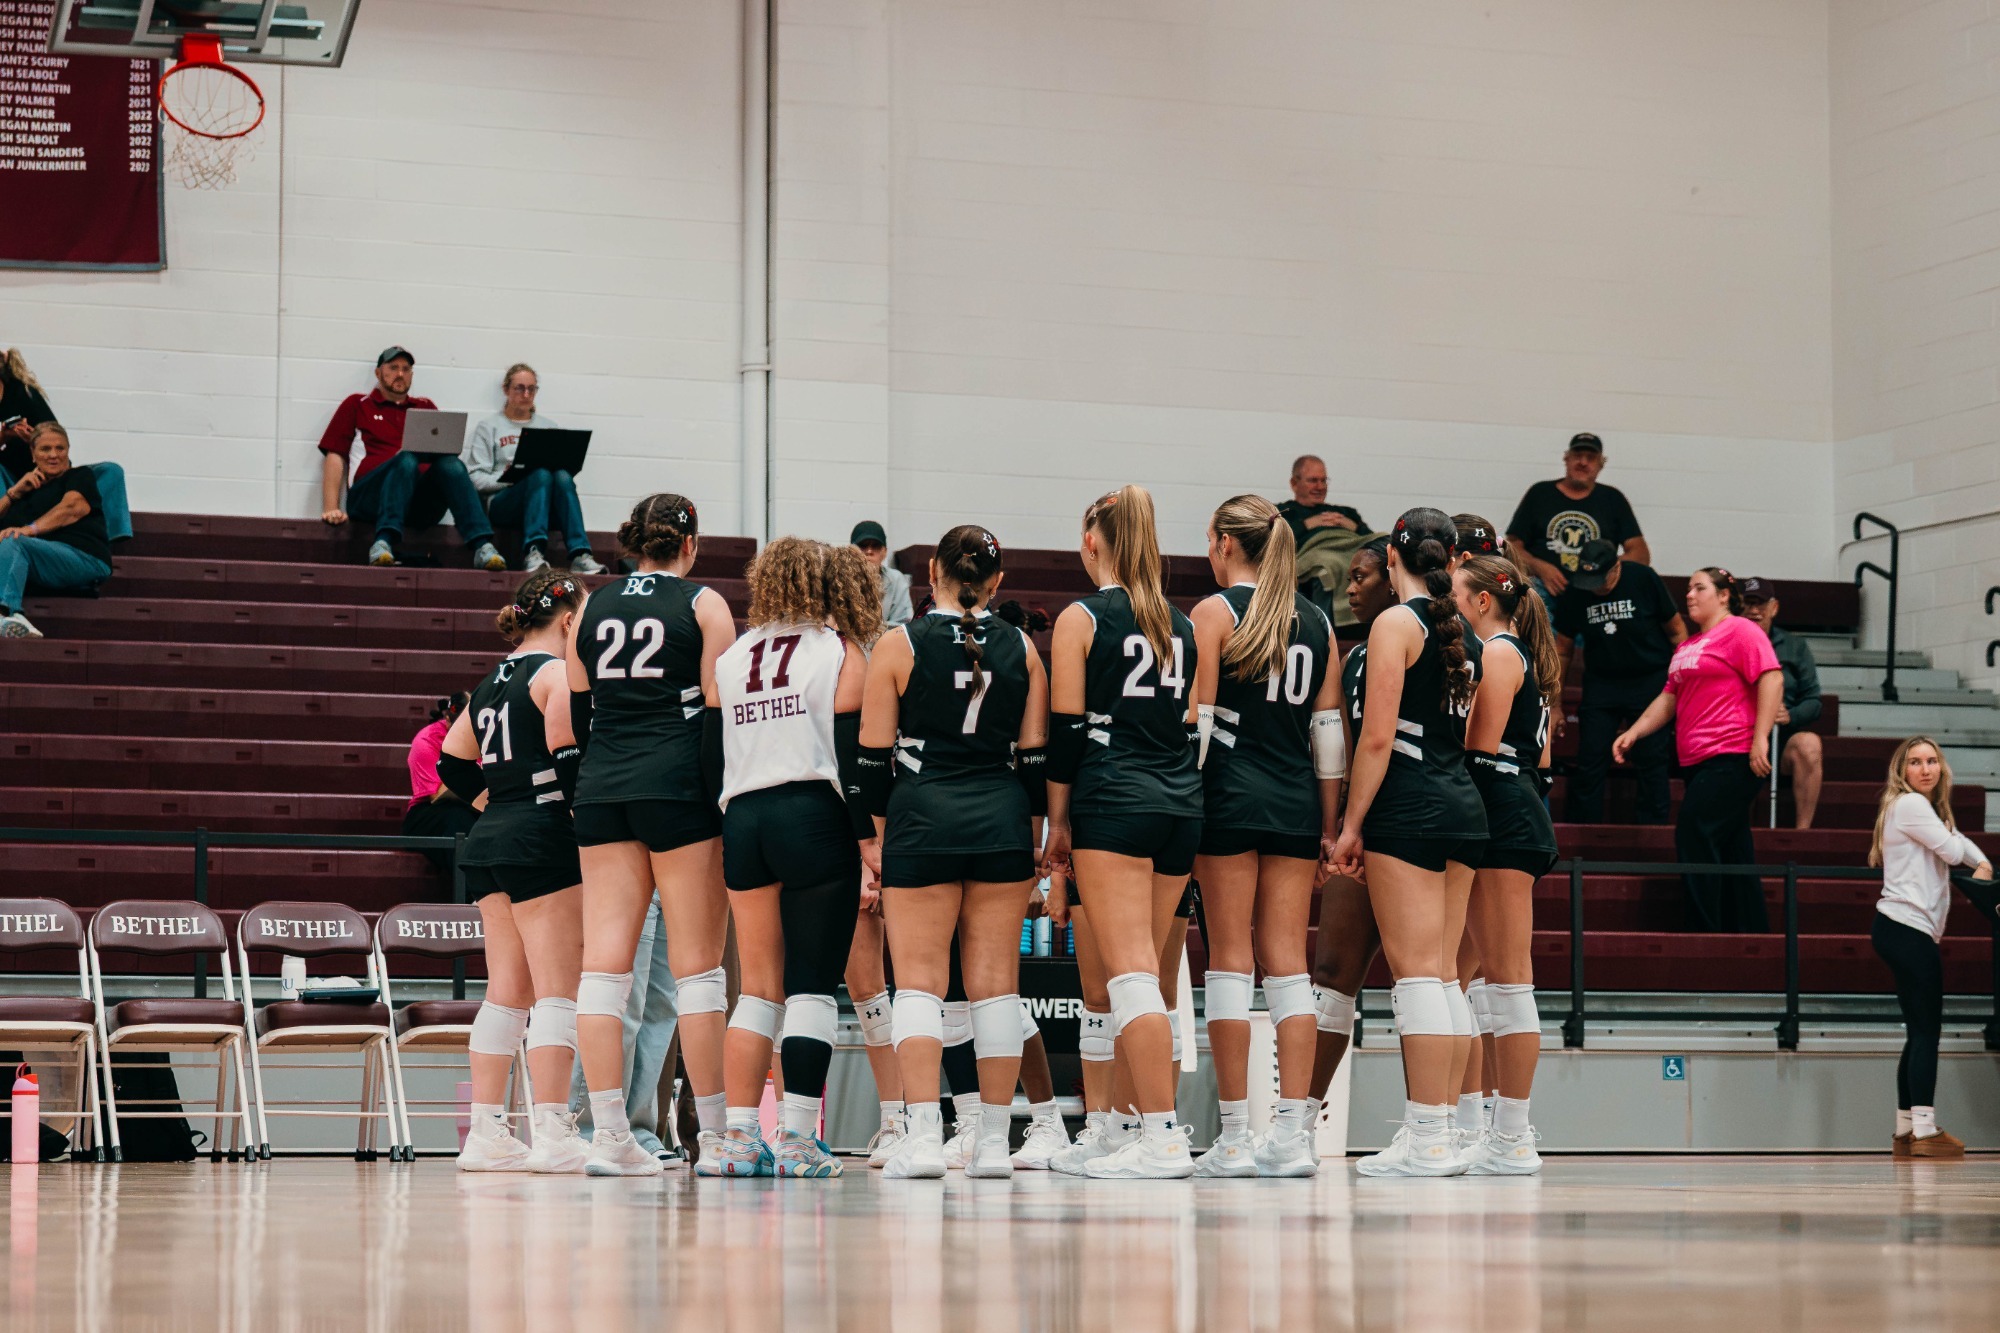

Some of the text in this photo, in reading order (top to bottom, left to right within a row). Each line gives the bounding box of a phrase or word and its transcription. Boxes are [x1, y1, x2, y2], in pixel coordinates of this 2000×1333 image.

[0, 2, 15, 12] SH
[0, 15, 49, 27] EGAN MA
[0, 28, 15, 39] SH
[0, 54, 151, 69] ANTZ SCURRY 2021
[16, 69, 59, 80] SEABOLT
[129, 72, 151, 82] 2021
[31, 83, 71, 94] MARTIN
[129, 85, 151, 95] 2021
[15, 95, 55, 106] PALMER
[129, 98, 151, 108] 2021
[15, 108, 55, 119] PALMER
[129, 111, 152, 121] 2022
[31, 122, 71, 132] MARTIN
[129, 123, 152, 134] 2022
[16, 134, 59, 145] SEABOLT
[129, 136, 152, 146] 2022
[0, 146, 151, 159] ENDEN SANDERS 2022
[16, 161, 87, 171] JUNKERMEIER
[499, 434, 520, 447] BE
[622, 577, 656, 596] BC
[597, 618, 665, 679] 22
[745, 634, 802, 694] 17
[1122, 634, 1185, 699] 24
[954, 671, 992, 734] 7
[733, 695, 807, 726] BETHEL
[477, 701, 512, 764] 21
[0, 914, 64, 933] THEL
[112, 915, 206, 936] BETHEL
[260, 918, 354, 939] BETHEL
[397, 919, 486, 940] BETHEL
